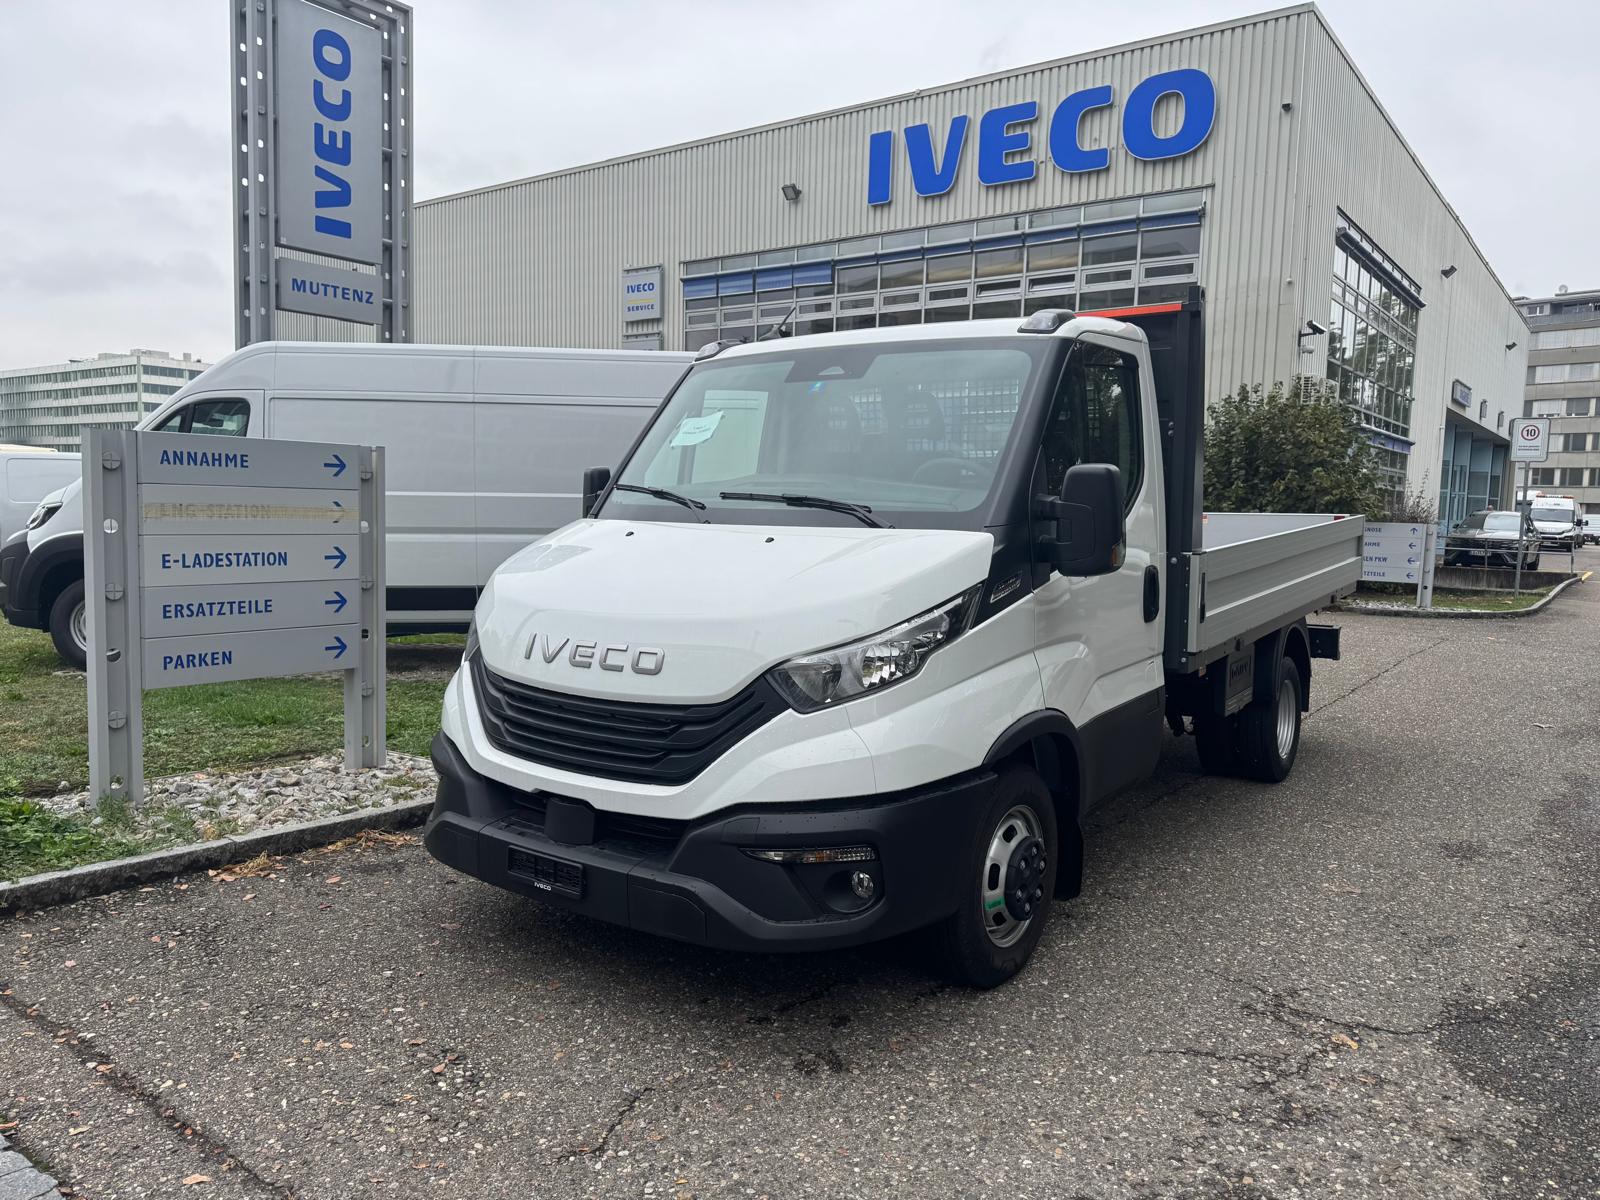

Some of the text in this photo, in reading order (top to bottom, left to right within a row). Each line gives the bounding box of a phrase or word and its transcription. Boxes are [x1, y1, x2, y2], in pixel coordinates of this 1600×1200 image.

[313, 29, 351, 239] IVECO
[867, 68, 1217, 206] IVECO
[291, 277, 374, 305] MUTTENZ
[626, 282, 655, 294] IVECO
[627, 303, 655, 313] SERVICE
[1525, 428, 1536, 437] 10
[160, 450, 249, 469] ANNAHME
[161, 551, 288, 570] E-LADESTATION
[162, 598, 273, 620] ERSATZTEILE
[163, 650, 233, 671] PARKEN
[524, 632, 665, 676] IVECO
